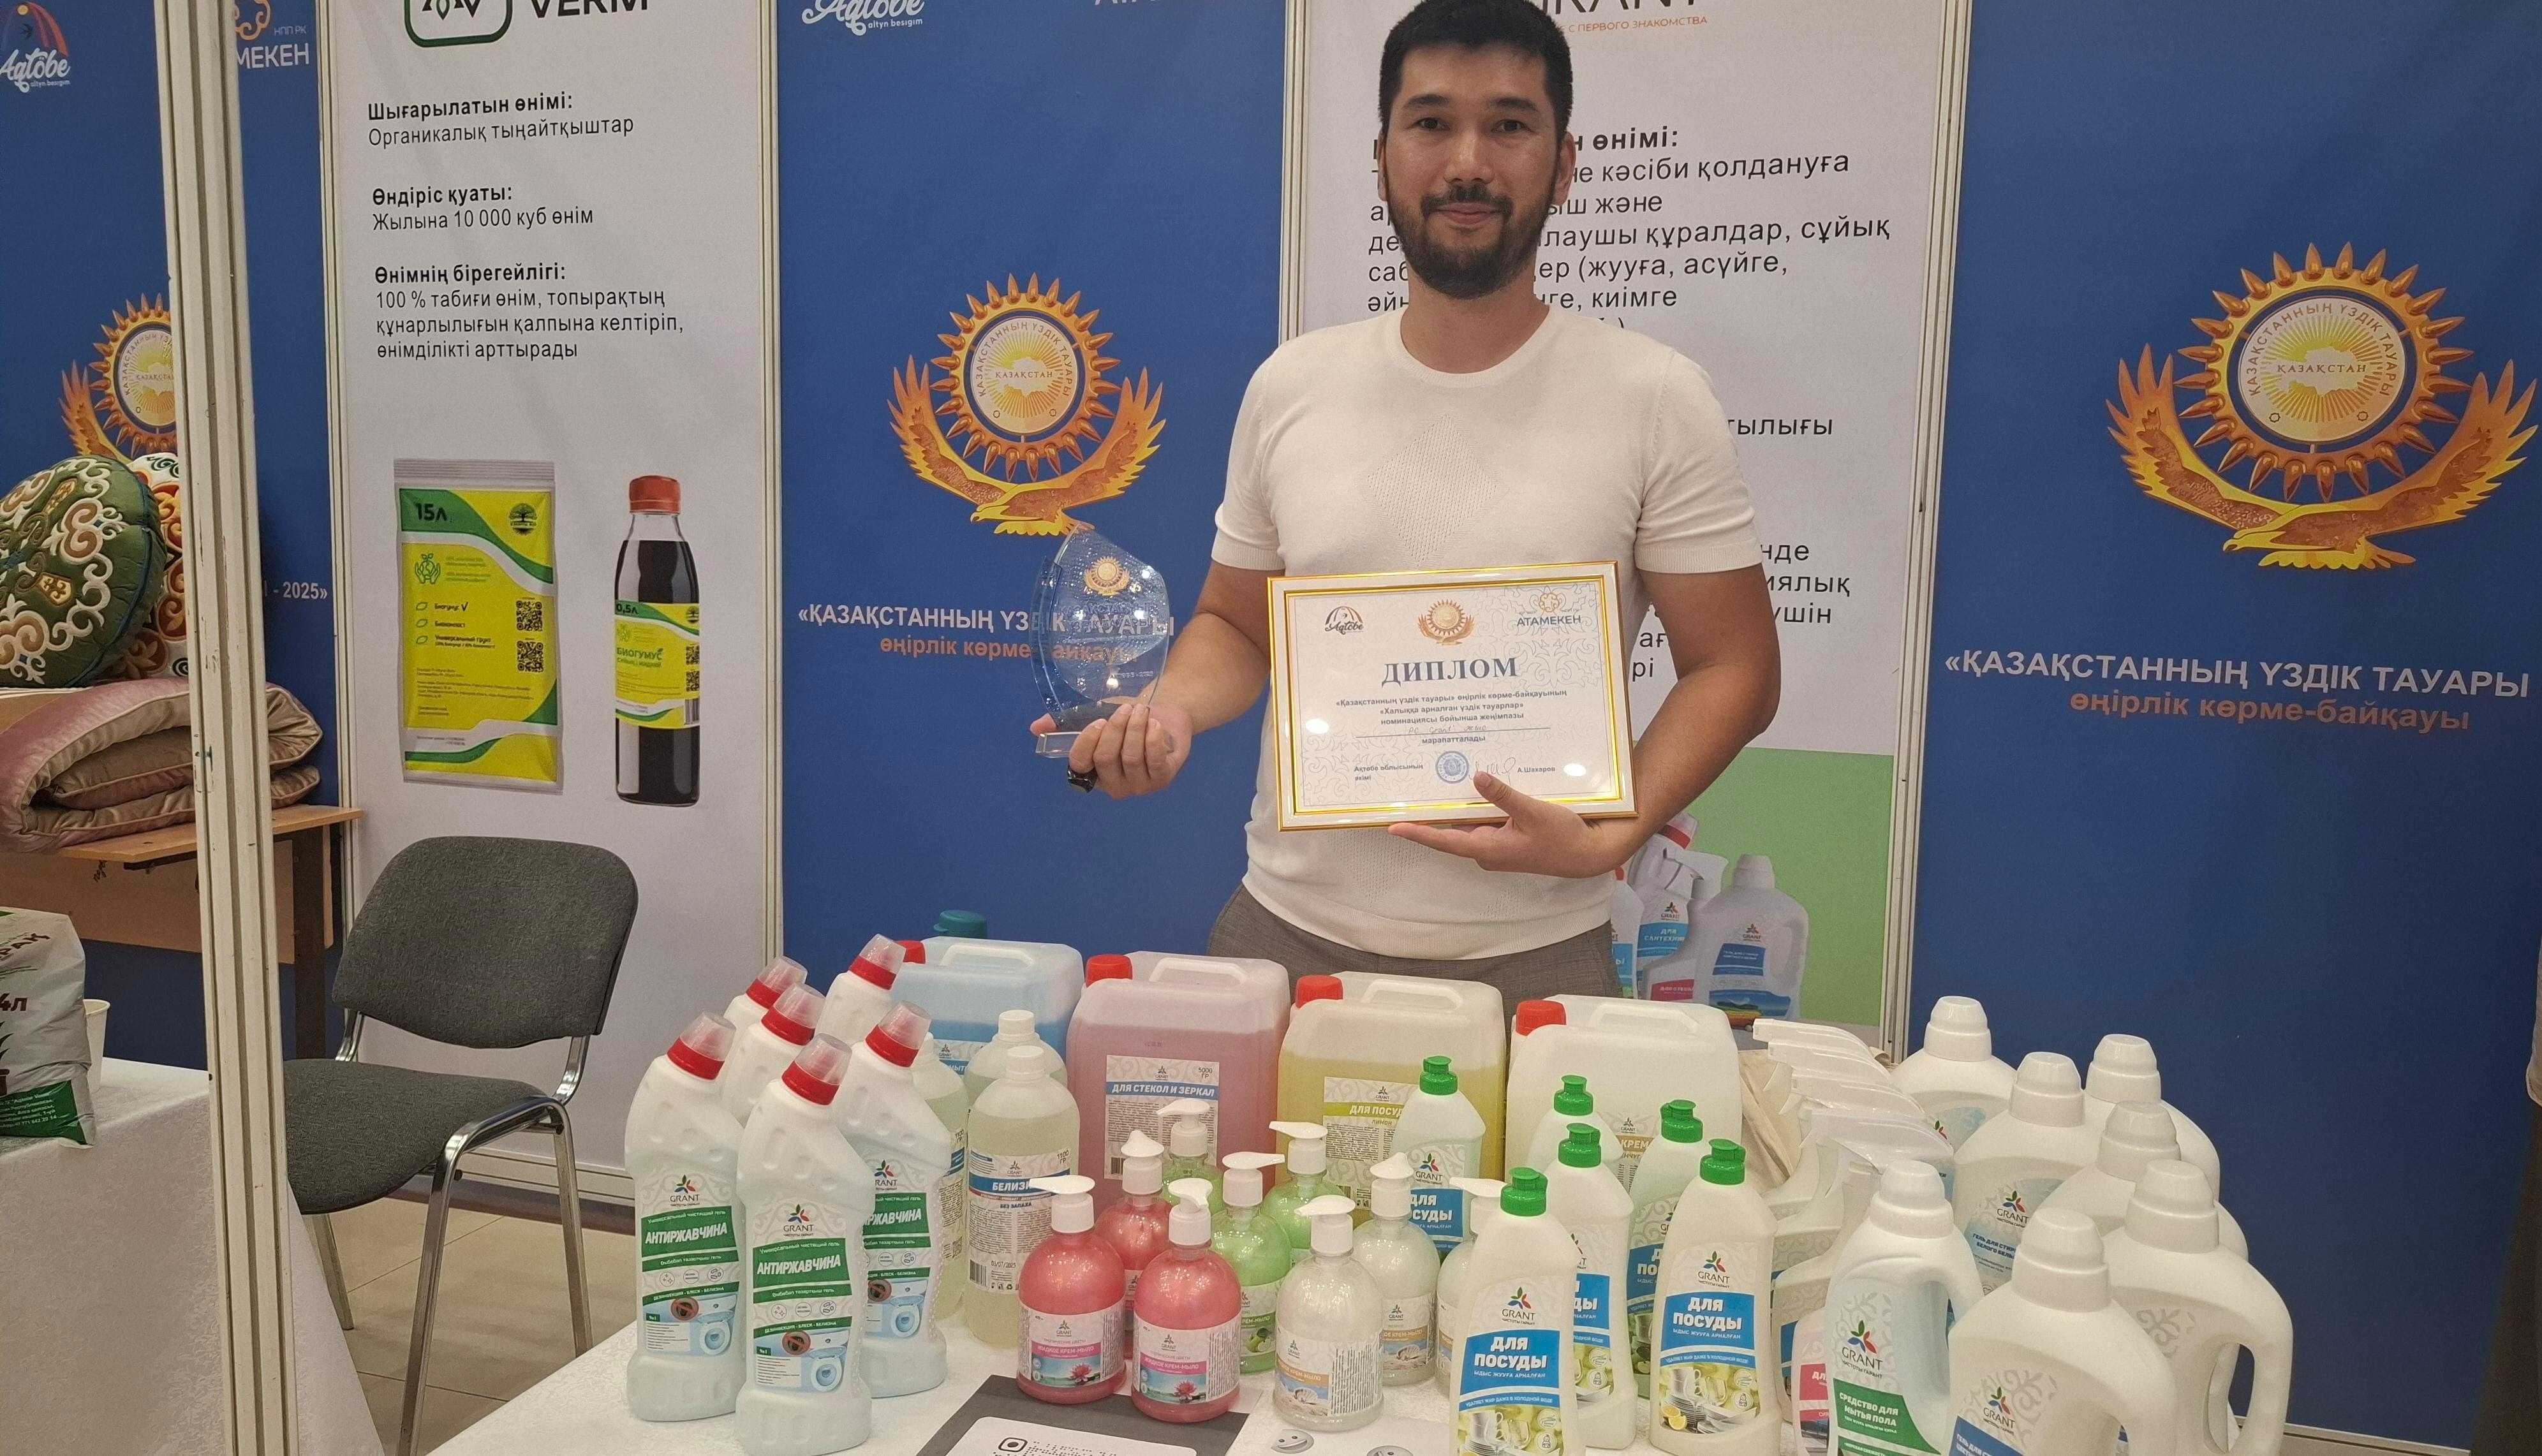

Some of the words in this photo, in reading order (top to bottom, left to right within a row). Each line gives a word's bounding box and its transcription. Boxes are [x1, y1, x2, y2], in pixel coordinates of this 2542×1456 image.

[1578, 21, 1629, 32] ПЕРВОГО
[1632, 16, 1708, 29] ЗНАКОМСТВА
[367, 99, 509, 121] Шығарылатын
[515, 92, 573, 112] өнімі:
[368, 126, 487, 149] Органикалық
[491, 117, 634, 140] тыңайтқыштар
[1593, 126, 1678, 151] өнімі:
[1602, 157, 1689, 182] кәсіби
[1698, 154, 1849, 182] қолдануға
[373, 187, 443, 208] Өндіріс
[448, 185, 513, 207] қуаты:
[1595, 195, 1663, 215] және
[373, 210, 448, 231] Жылына
[454, 209, 474, 228] 10
[479, 208, 511, 228] 000
[517, 207, 547, 230] куб
[552, 205, 593, 224] өнім
[1646, 222, 1791, 249] құралдар,
[1801, 215, 1891, 244] сұйық
[374, 265, 448, 285] Өнімнің
[453, 262, 566, 286] бірегейлігі:
[1579, 255, 1674, 283] (жууға,
[1683, 251, 1787, 279] асүйге,
[376, 291, 406, 309] 100
[411, 290, 427, 309] %
[431, 289, 491, 307] табиғи
[496, 289, 542, 309] өнім,
[547, 289, 666, 310] топырақтың
[1592, 286, 1677, 309] киімге
[376, 318, 509, 338] құнарлылығын
[514, 316, 595, 335] қалпына
[600, 313, 684, 335] келтіріп,
[377, 340, 470, 361] өнімділікті
[475, 341, 578, 361] арттырады
[1032, 323, 1061, 346] ҮЗДІК
[1059, 346, 1073, 397] ТАУАРЫ
[2340, 304, 2383, 332] ҮЗДІК
[2379, 333, 2398, 396] ТАУАРЫ
[2277, 364, 2367, 374] ҚАЗАҚСТАН
[283, 581, 328, 600] 2025»
[799, 603, 994, 633] «ҚАЗАҚСТАННЫҢ
[1517, 615, 1581, 627] АТАМЕКЕН
[880, 635, 957, 658] өңірлік
[1381, 657, 1518, 689] ДИПЛОМ
[1944, 651, 2249, 689] «ҚАЗАҚСТАННЫҢ
[2260, 661, 2363, 694] ҮЗДІК
[2372, 666, 2531, 700] ТАУАРЫ
[1400, 696, 1419, 705] үздік
[1458, 692, 1486, 702] өңірлік
[1488, 689, 1567, 700] көрме-байқауының
[1421, 705, 1458, 714] арналған
[1459, 703, 1481, 712] үздік
[1439, 714, 1478, 723] бойынша
[1479, 712, 1524, 721] жеңімпазы
[2070, 690, 2189, 719] өңірлік
[2199, 696, 2471, 735] көрме-байқауы
[1422, 735, 1486, 745] марапатталады
[1112, 1084, 1132, 1094] ДЛЯ
[1133, 1085, 1169, 1094] СТЕКОЛ
[1170, 1086, 1178, 1094] И
[1178, 1087, 1215, 1097] ЗЕРКАЛ
[1349, 1105, 1370, 1115] ДЛЯ
[1415, 1171, 1442, 1181] GRANT
[670, 1194, 700, 1203] GRANT
[1997, 1208, 2029, 1224] GRANT
[645, 1222, 728, 1244] АНТИРЖАВЧИНА
[783, 1224, 814, 1233] GRANT
[757, 1254, 841, 1276] АНТИРЖАВЧИНА
[1697, 1271, 1730, 1284] GRANT
[1502, 1309, 1536, 1321] GRANT
[1688, 1297, 1724, 1313] ДЛЯ
[1673, 1312, 1743, 1332] ПОСУДЫ
[1490, 1336, 1528, 1353] ДЛЯ
[1474, 1353, 1548, 1371] ПОСУДЫ
[1842, 1346, 1883, 1371] GRANT
[1840, 1392, 1877, 1411] СРЕДСТВО
[1879, 1406, 1898, 1416] ДЛЯ
[1844, 1405, 1872, 1421] МЫТЬЯ
[1873, 1415, 1896, 1427] ПОЛА
[1983, 1407, 2016, 1429] GRANT
